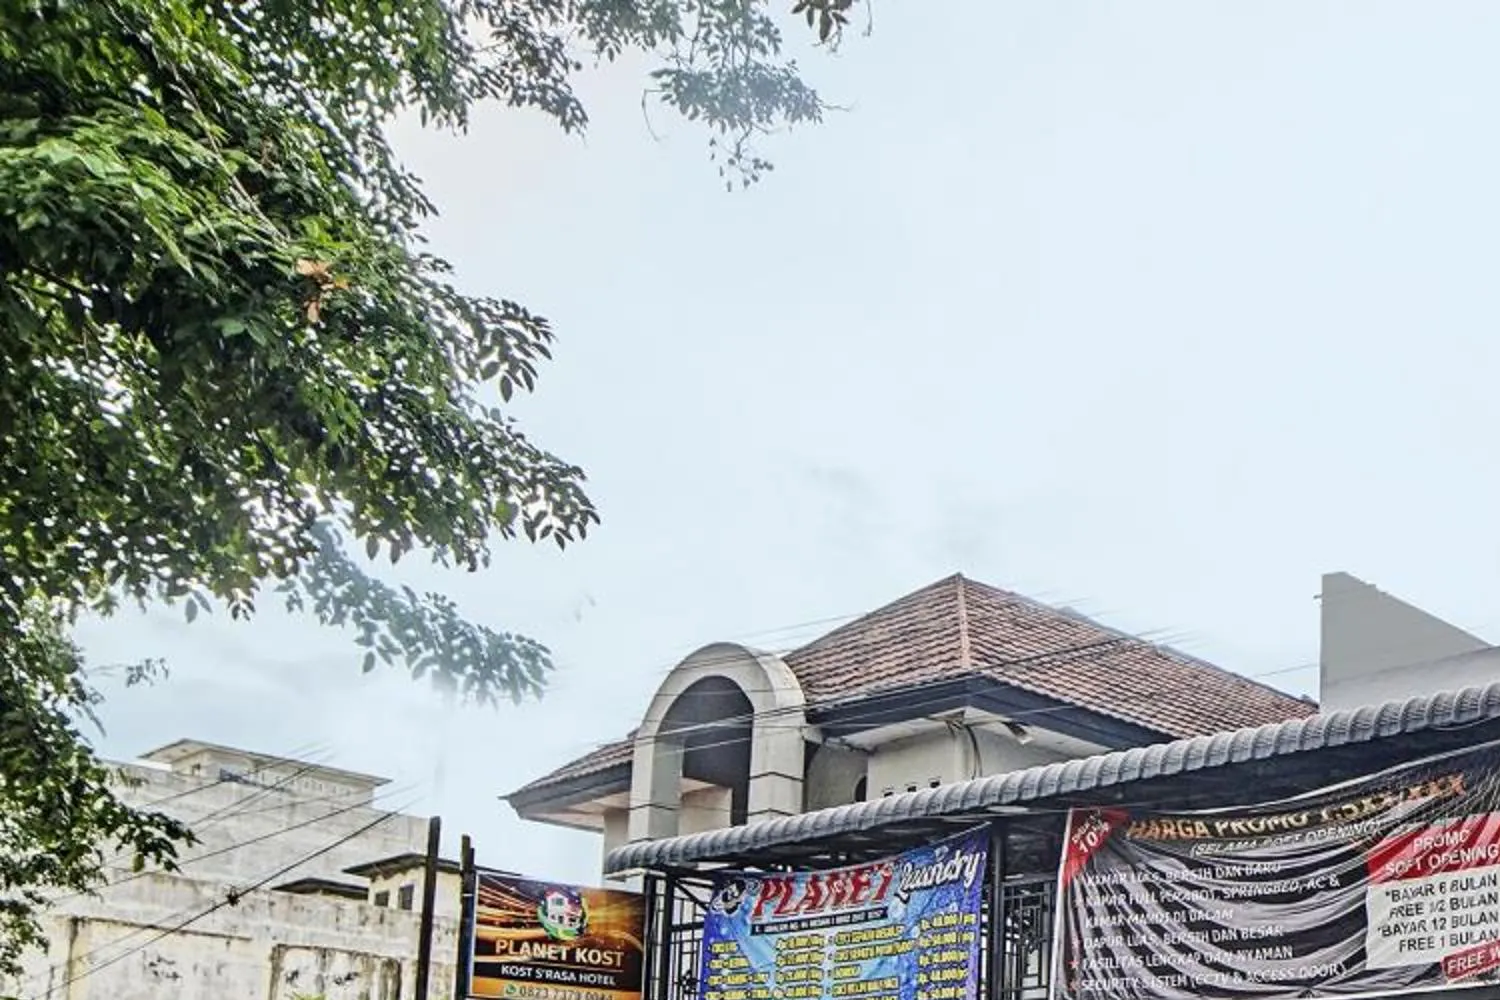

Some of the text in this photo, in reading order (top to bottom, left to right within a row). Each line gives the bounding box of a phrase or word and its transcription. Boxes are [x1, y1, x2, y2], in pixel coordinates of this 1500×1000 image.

[1126, 818, 1212, 840] HARGA
[1413, 829, 1470, 852] PROMO
[1428, 843, 1500, 870] OPENING
[896, 850, 987, 903] Laundry
[1450, 873, 1498, 892] BULAN
[1389, 901, 1425, 919] FREE
[1450, 891, 1499, 911] BULAN
[1432, 917, 1447, 931] 12
[1451, 911, 1499, 929] BULAN
[1399, 929, 1499, 953] FREE 1 BULAN
[495, 939, 624, 968] PLANET KOST
[1447, 953, 1486, 974] FREE
[501, 963, 617, 986] KOST S'RASA HOTEL
